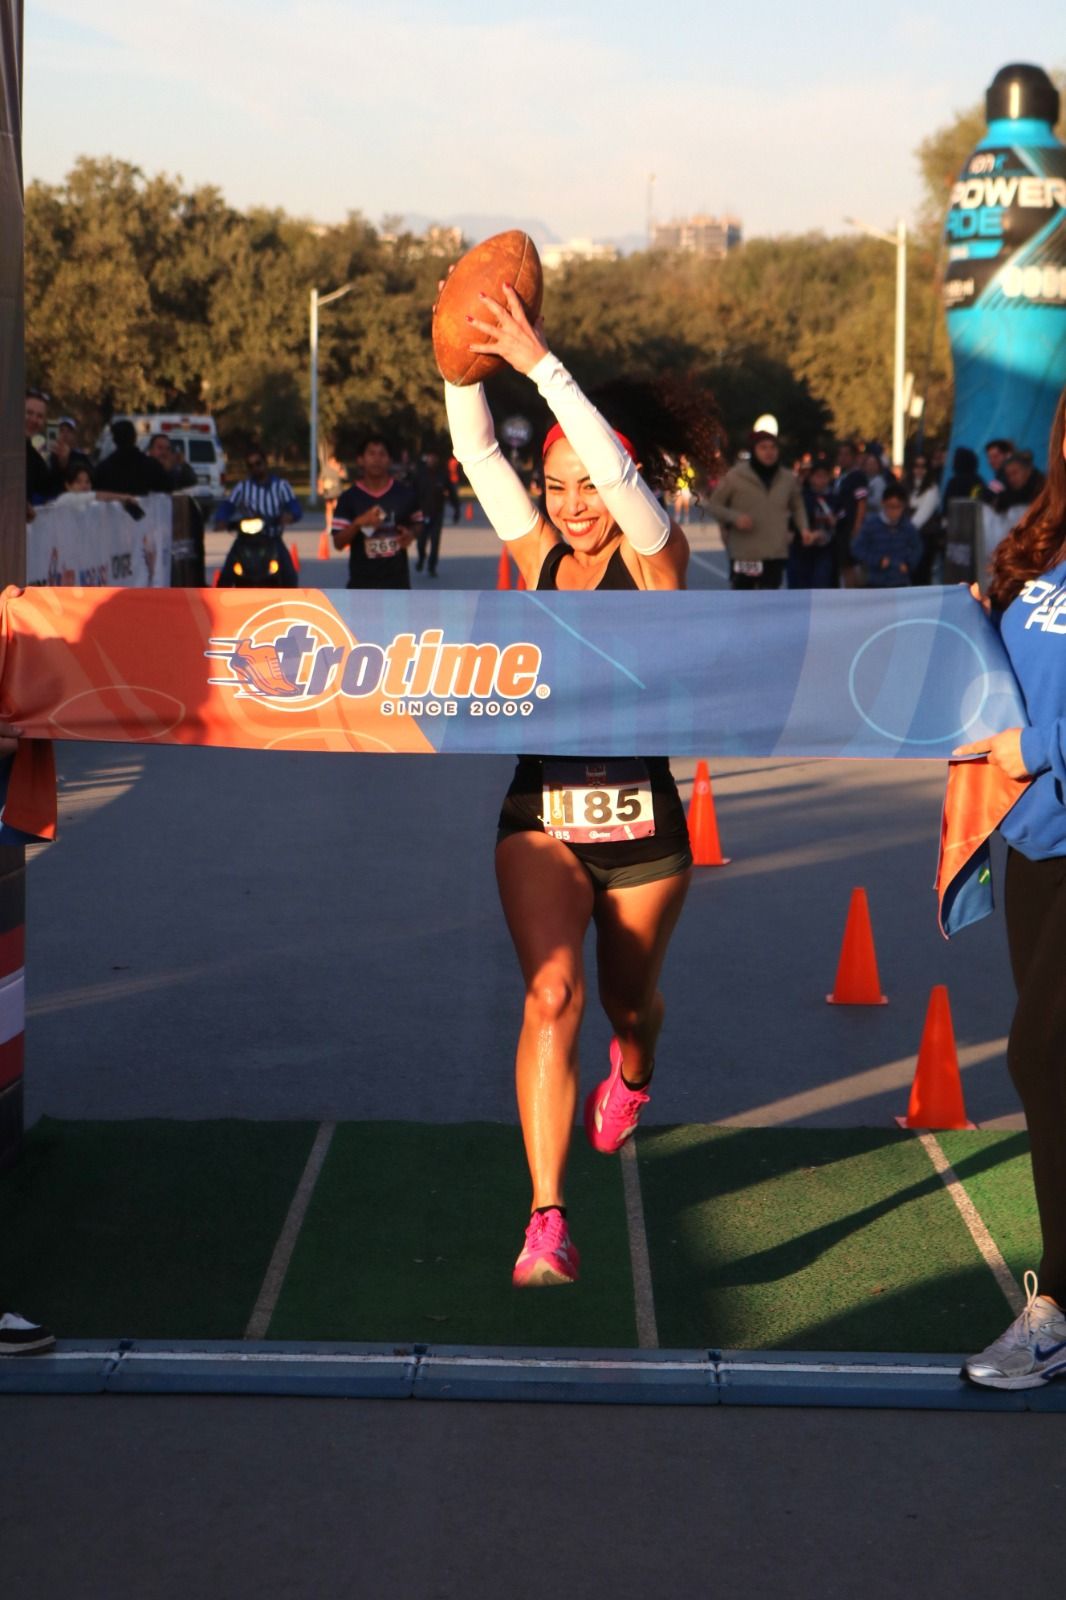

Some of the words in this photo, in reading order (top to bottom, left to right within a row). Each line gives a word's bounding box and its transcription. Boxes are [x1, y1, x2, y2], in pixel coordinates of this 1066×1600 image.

[381, 701, 458, 716] SINCE
[470, 701, 534, 716] 2009
[563, 789, 641, 824] 185
